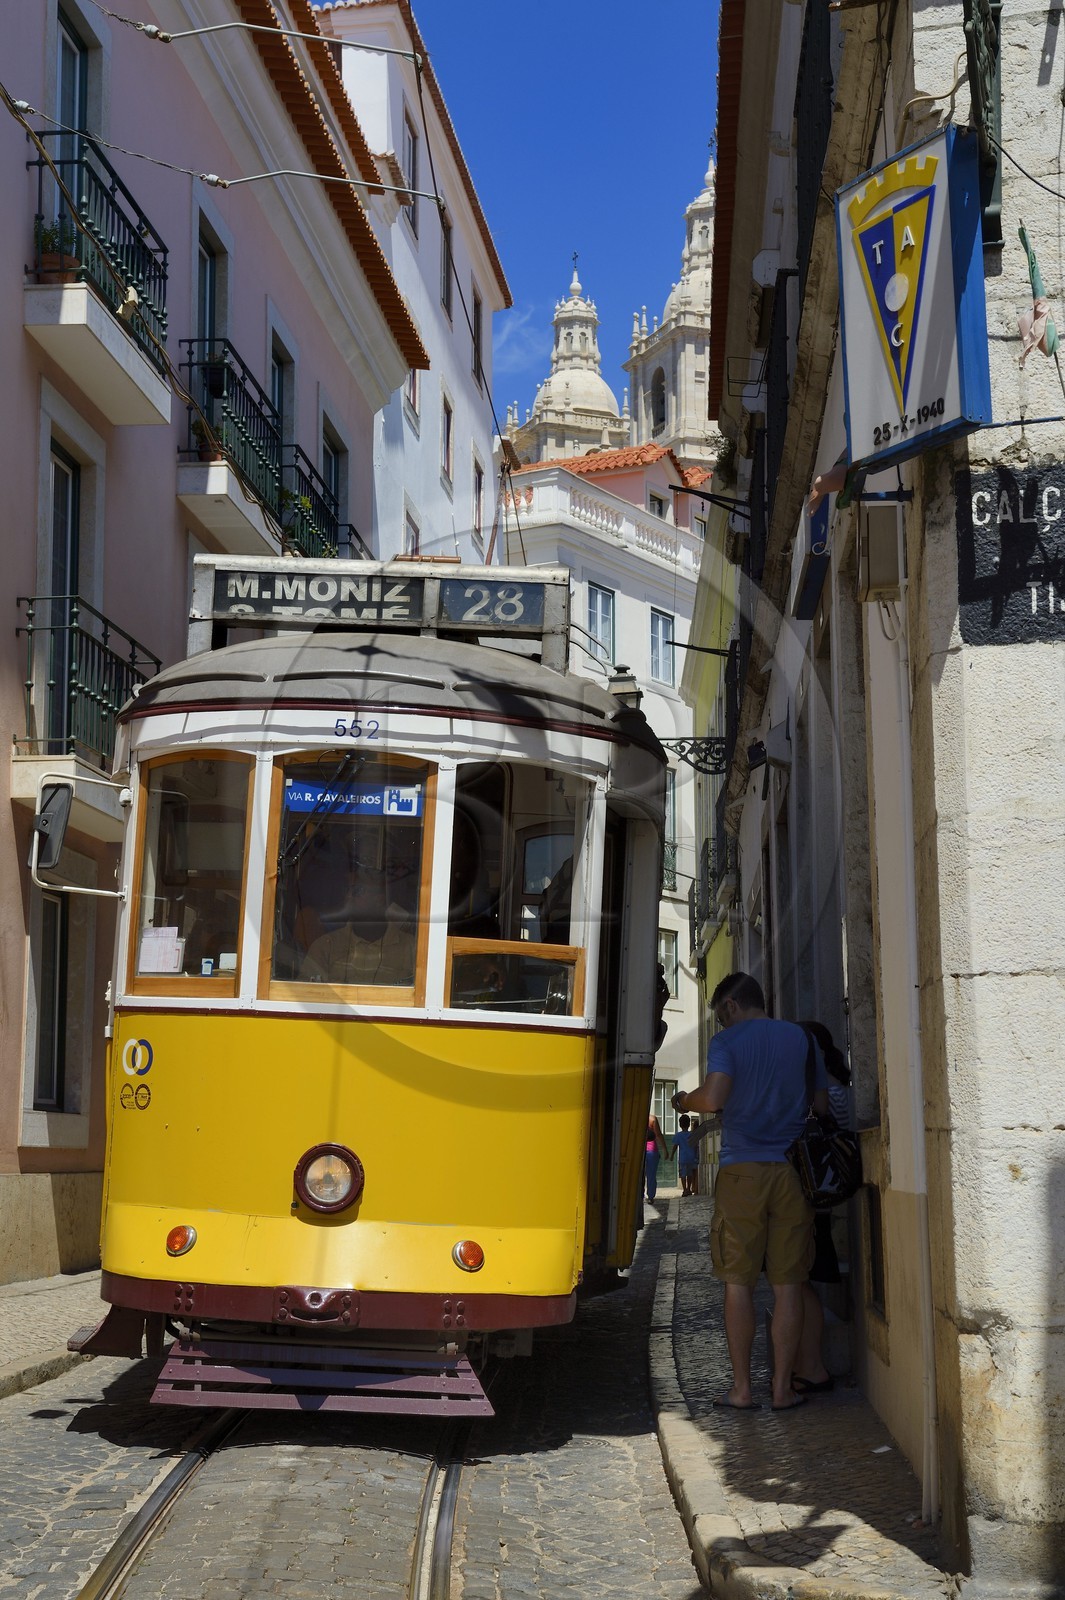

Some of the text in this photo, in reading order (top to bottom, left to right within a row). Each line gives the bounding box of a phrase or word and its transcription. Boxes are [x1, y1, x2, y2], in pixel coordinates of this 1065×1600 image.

[872, 225, 915, 265] T A
[890, 322, 905, 347] C
[873, 397, 945, 446] 25-X-1940
[227, 572, 411, 603] M.MONIZ
[462, 583, 525, 622] 28
[1026, 581, 1065, 614] TI
[334, 718, 380, 740] 552
[287, 790, 381, 805] VIA R. CAVALEIROS
